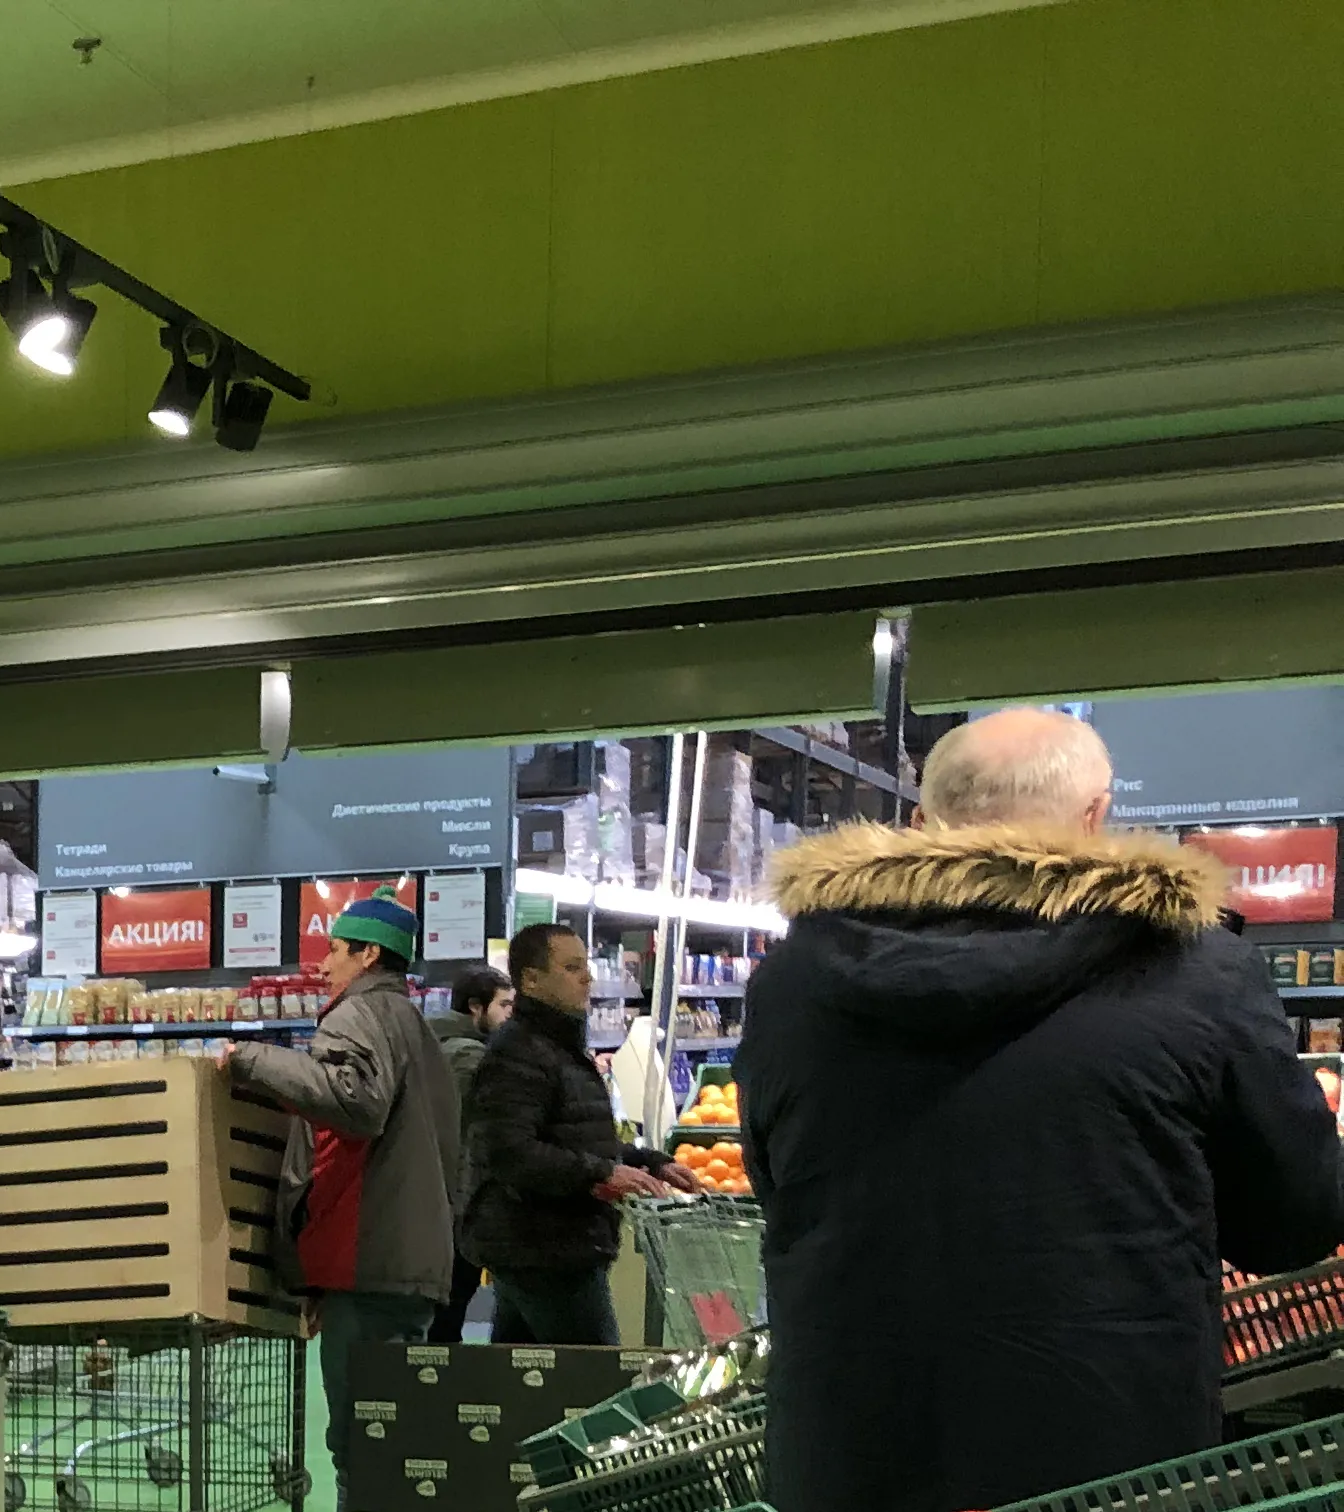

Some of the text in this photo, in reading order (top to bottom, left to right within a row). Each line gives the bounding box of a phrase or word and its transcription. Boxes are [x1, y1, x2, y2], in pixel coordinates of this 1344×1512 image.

[424, 797, 492, 812] продукты
[56, 843, 107, 856] Тетради
[55, 861, 193, 878] Канцелярские товары
[108, 920, 204, 947] АКЦИЯ!
